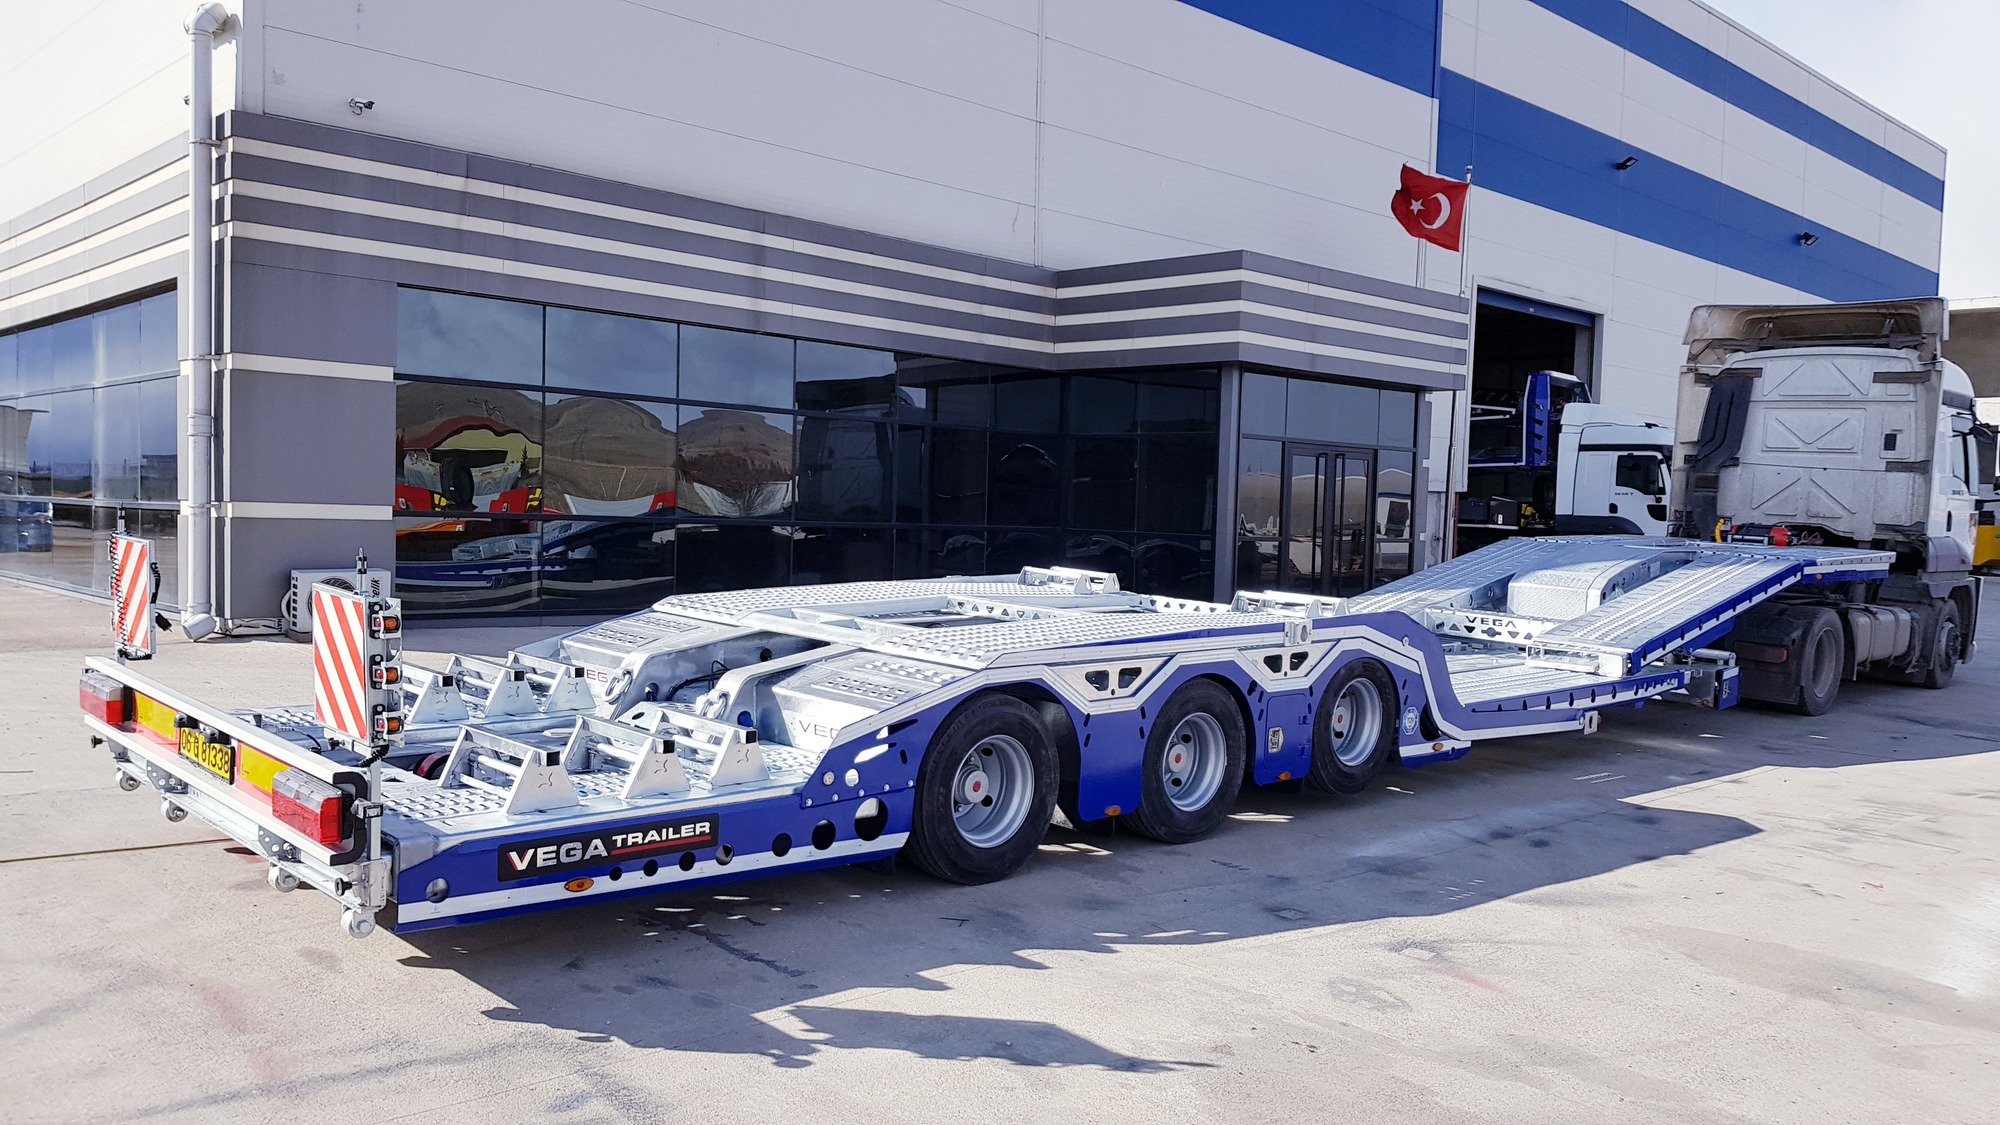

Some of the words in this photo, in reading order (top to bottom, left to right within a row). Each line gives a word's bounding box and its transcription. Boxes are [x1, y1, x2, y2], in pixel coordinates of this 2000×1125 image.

[1465, 615, 1517, 629] VEGA
[586, 669, 609, 684] EG
[182, 729, 191, 753] 06
[201, 740, 230, 774] 81338
[507, 839, 609, 871] VEGA
[612, 821, 711, 848] TRAILER
